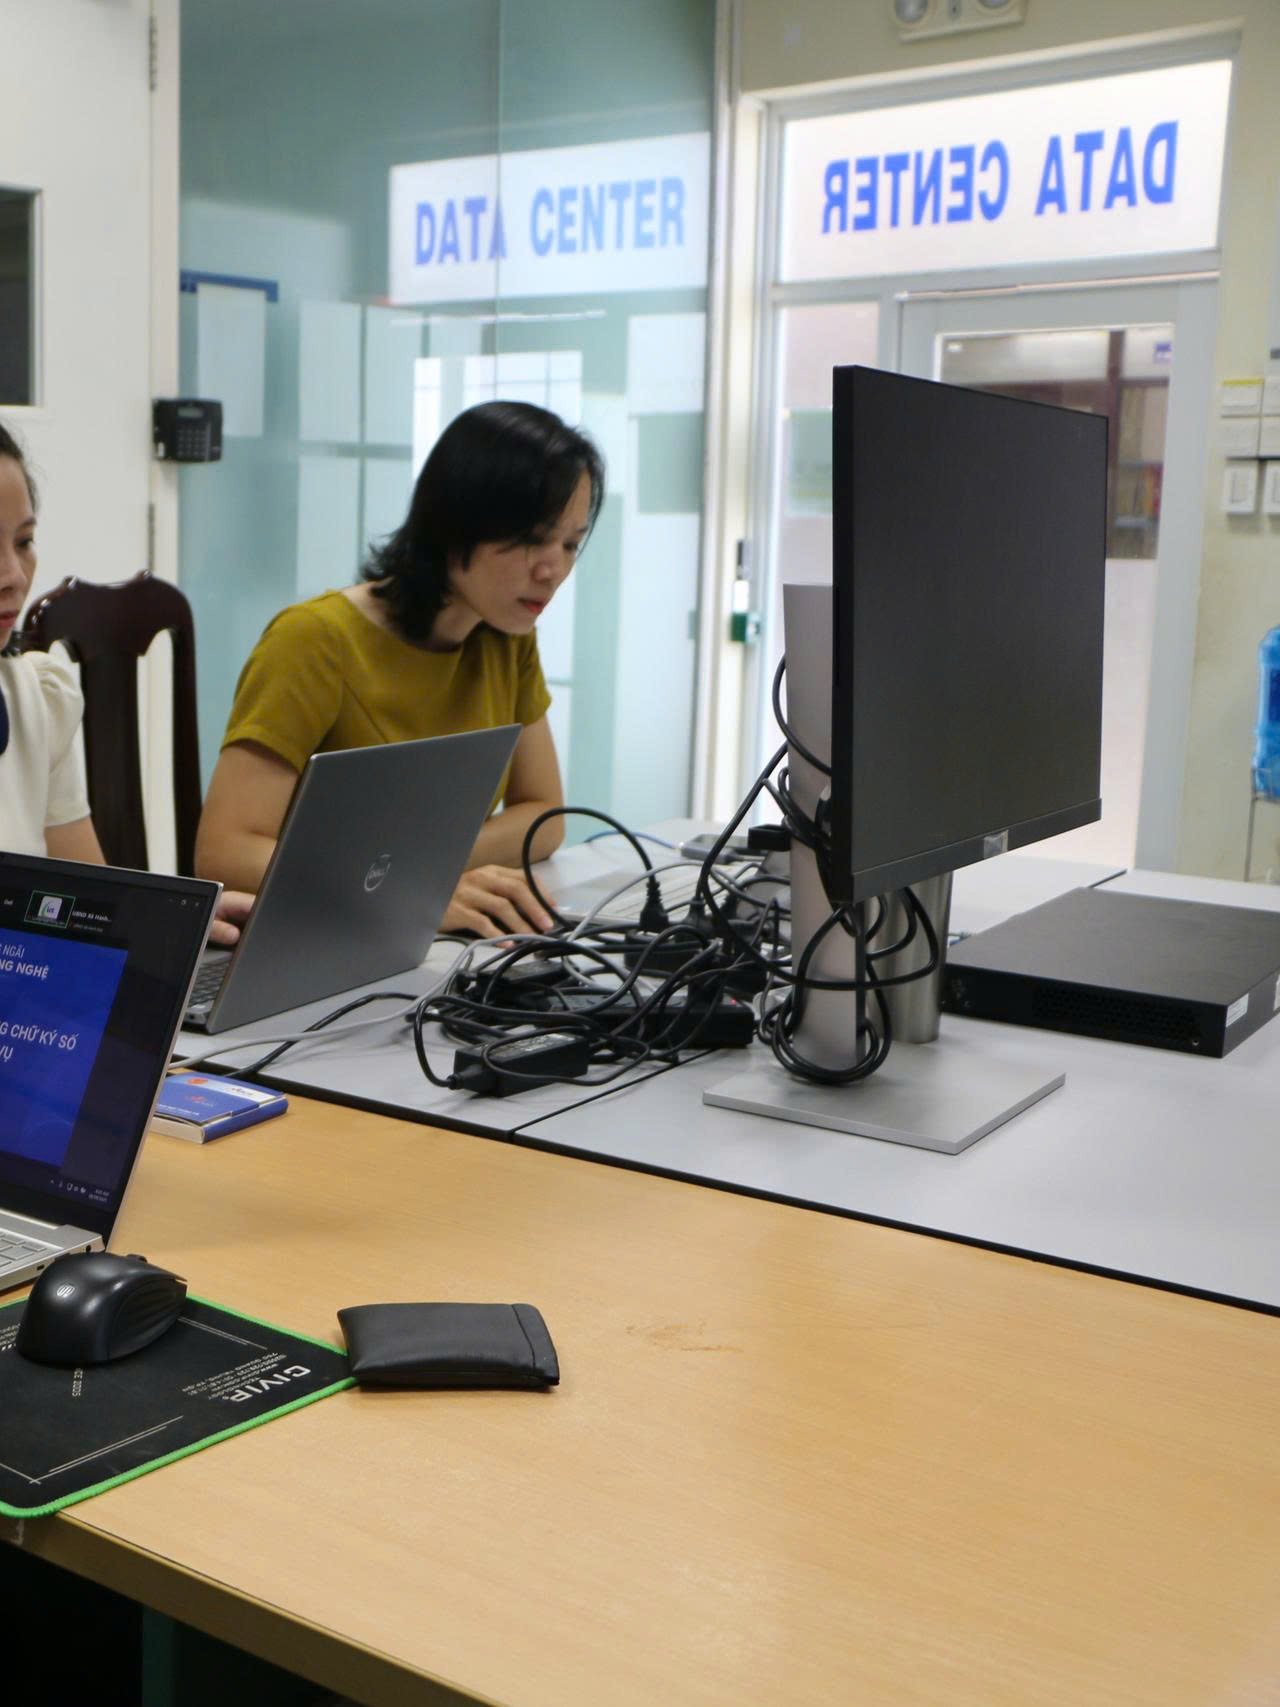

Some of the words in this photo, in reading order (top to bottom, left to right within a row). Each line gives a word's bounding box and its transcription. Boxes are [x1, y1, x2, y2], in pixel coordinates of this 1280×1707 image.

[414, 195, 508, 266] DATA
[529, 175, 687, 257] CENTER
[2, 943, 25, 959] NGÃI
[15, 961, 50, 981] NGHỆ
[10, 1024, 40, 1042] CHỮ
[39, 1029, 58, 1046] KÝ
[58, 1032, 80, 1051] SỐ
